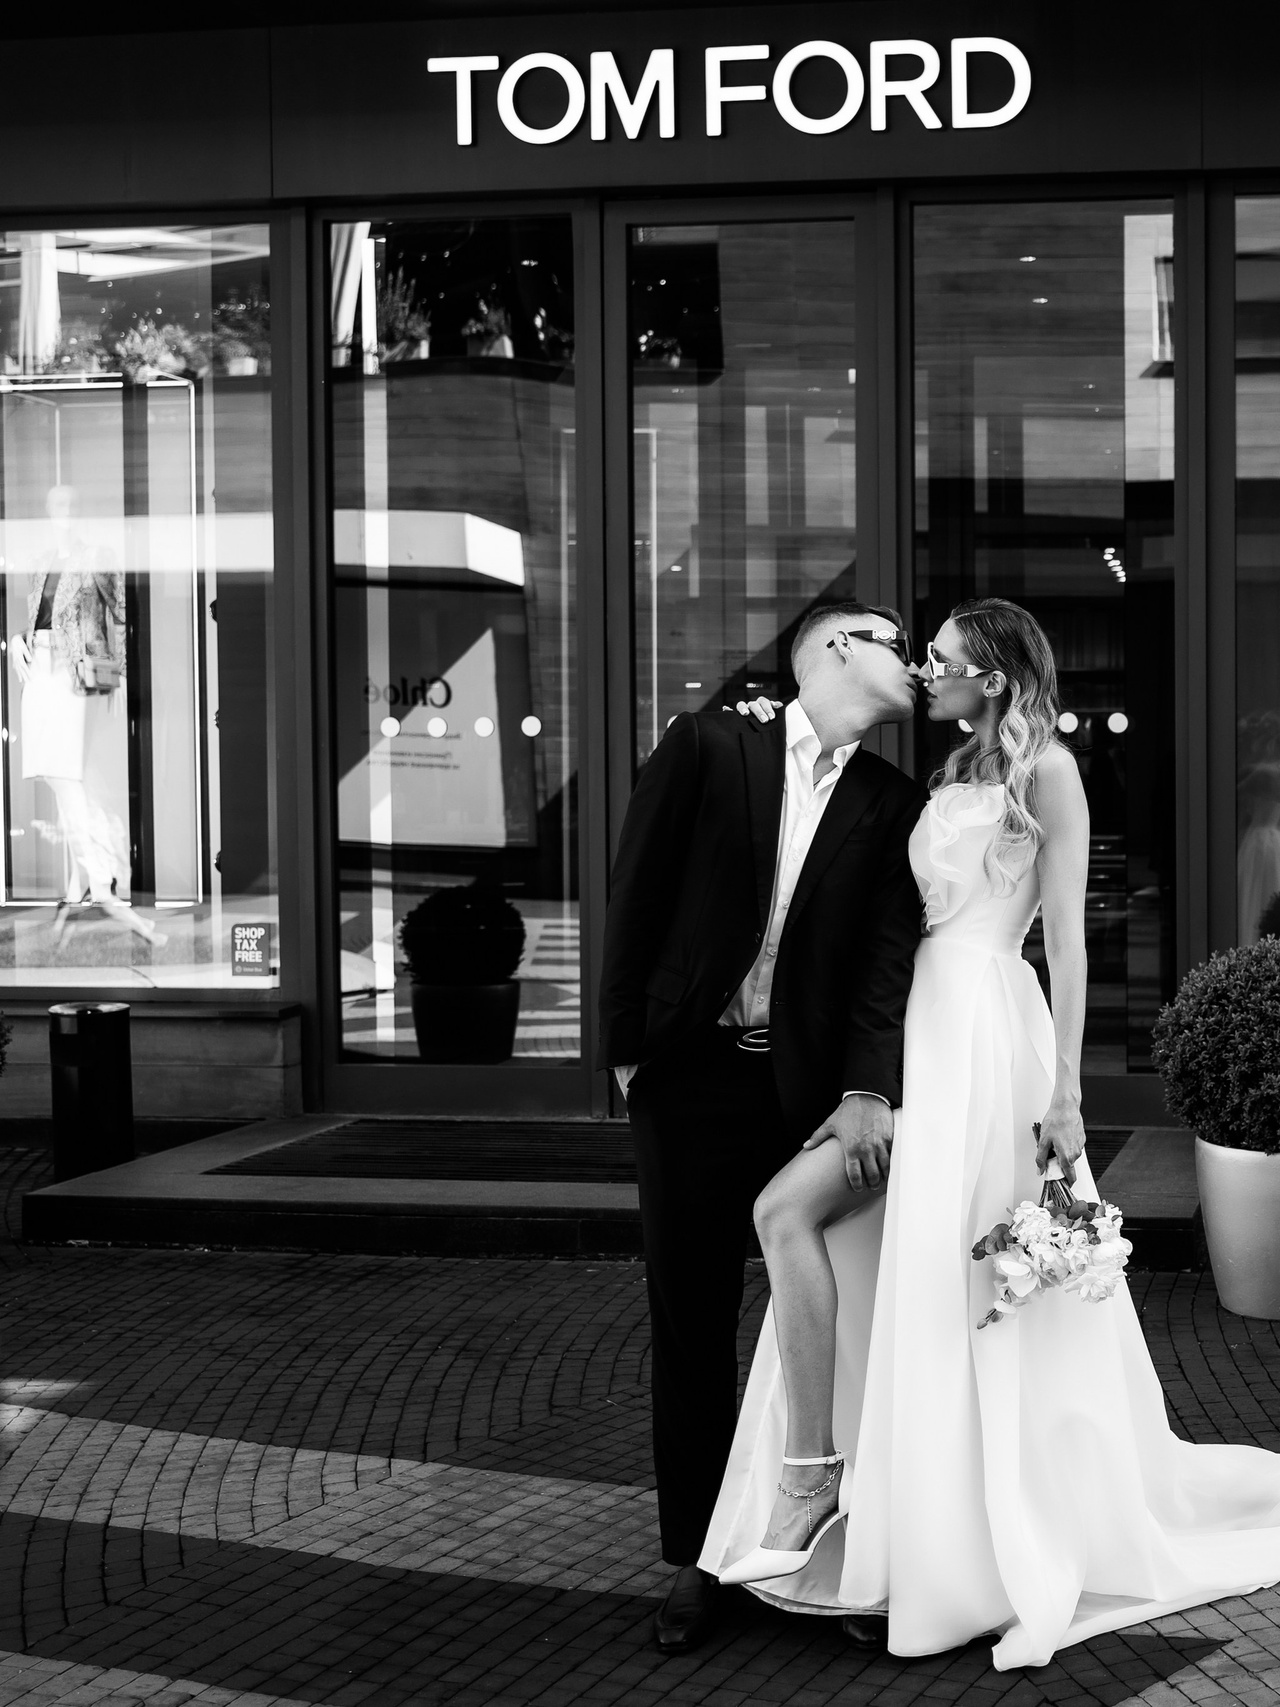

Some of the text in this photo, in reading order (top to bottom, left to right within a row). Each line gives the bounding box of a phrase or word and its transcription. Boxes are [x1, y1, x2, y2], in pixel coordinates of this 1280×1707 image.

[427, 36, 1032, 146] TOM FORD
[234, 927, 265, 939] SHOP
[234, 939, 258, 950] TAX
[234, 951, 263, 962] FREE
